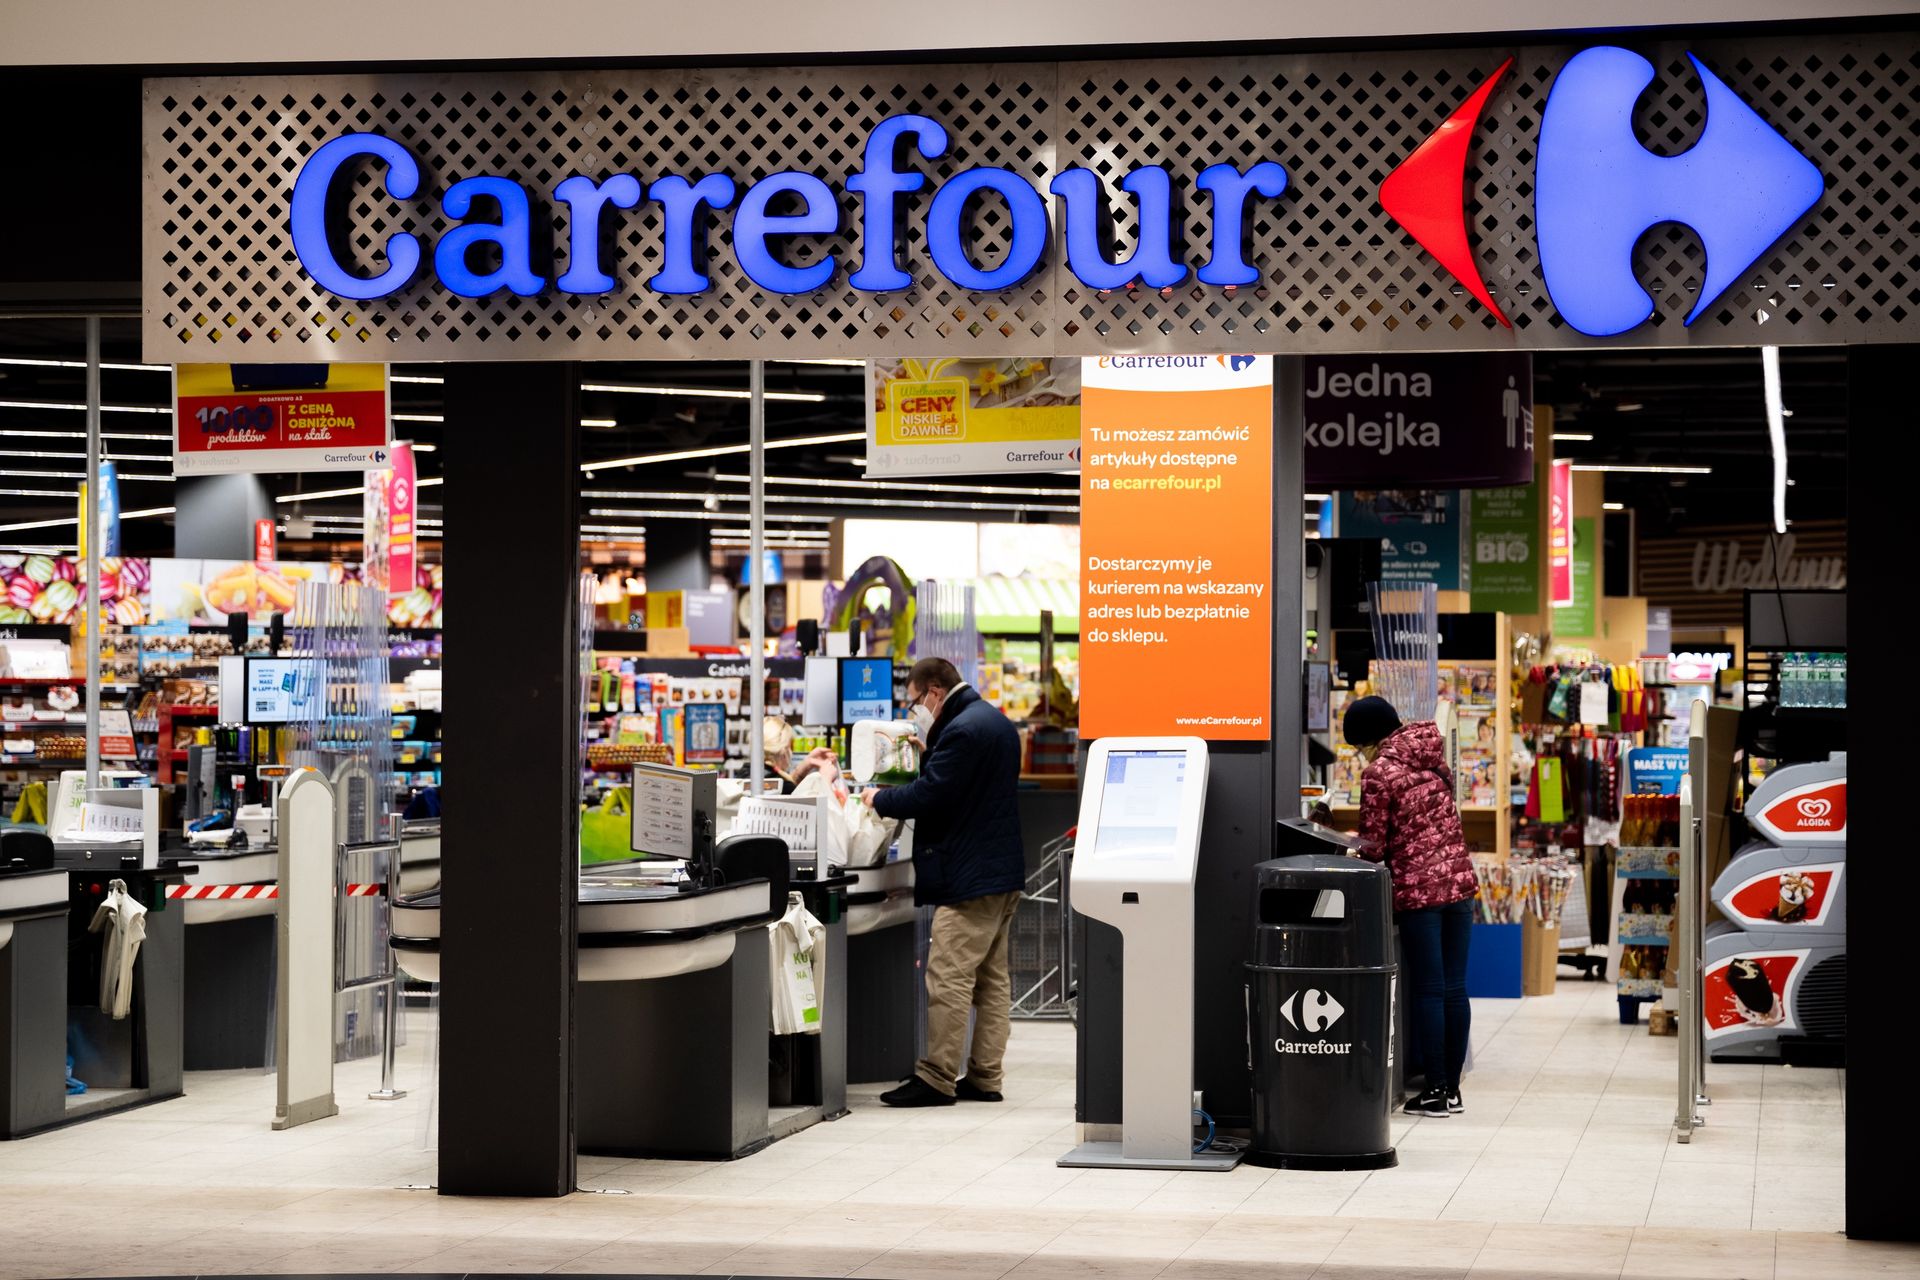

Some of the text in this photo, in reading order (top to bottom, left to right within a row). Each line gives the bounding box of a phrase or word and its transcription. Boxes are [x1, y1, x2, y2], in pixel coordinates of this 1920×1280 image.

[289, 113, 1289, 301] Carrefour
[1306, 362, 1432, 399] Jedna
[288, 403, 335, 415] Z CENĄ
[901, 396, 956, 414] CENY
[195, 404, 275, 433] 1000
[288, 416, 356, 430] OBNIŻONĄ
[901, 414, 942, 425] NISKIE
[207, 428, 267, 450] produktów
[288, 427, 332, 441] na stałe
[900, 424, 958, 437] DAWNIEJ
[1090, 425, 1250, 442] Tu możesz zamówić
[1303, 411, 1441, 456] kolejka
[324, 453, 366, 463] Carrefour
[1006, 451, 1065, 462] Carrefour
[1090, 451, 1238, 469] artykuły dostępne
[1090, 475, 1222, 493] na ecarrefour.pl
[1476, 540, 1529, 563] BIO
[1088, 556, 1212, 574] Dostarczymy je
[1088, 580, 1264, 598] kurierem na wskazany
[1088, 604, 1250, 622] adres lub bezpłatnie
[1088, 628, 1168, 646] do sklepu.
[849, 707, 874, 717] Carrefour
[1176, 716, 1262, 727] www.eCarrefour.pl
[1633, 760, 1665, 771] MASZ
[1666, 760, 1677, 770] W
[1796, 818, 1831, 827] ALGIDA
[1275, 1038, 1352, 1054] Carrefour
